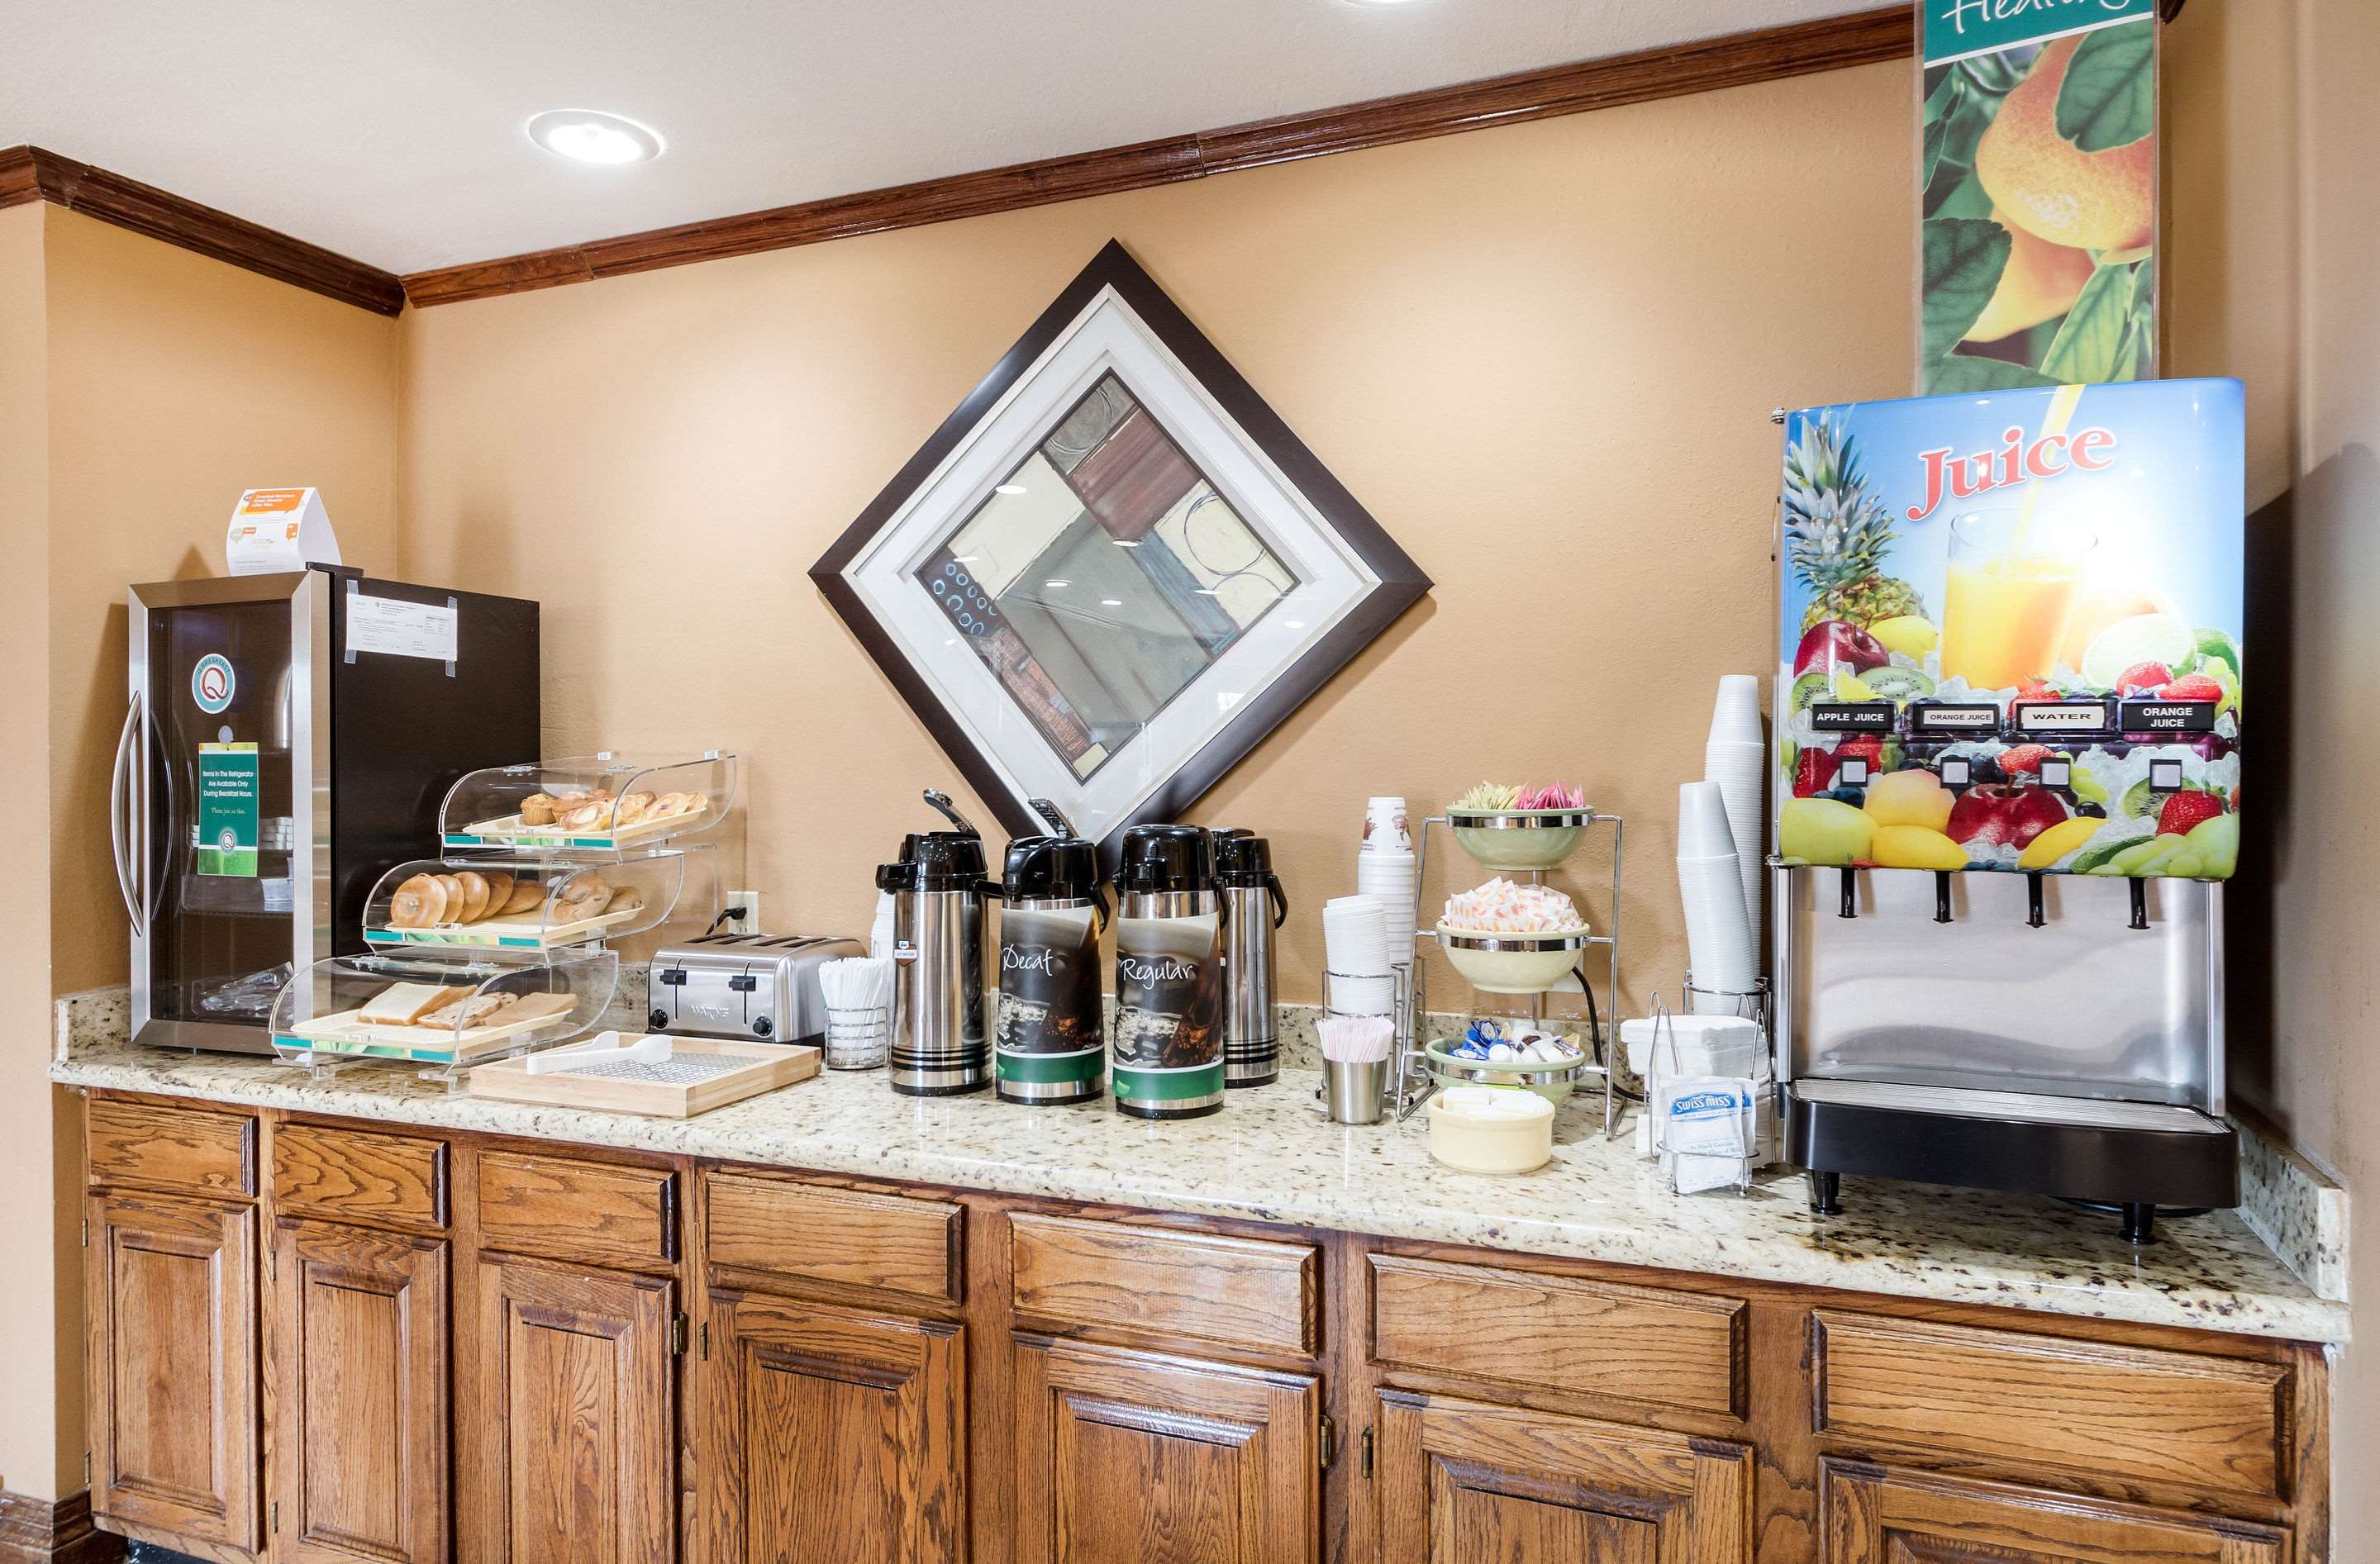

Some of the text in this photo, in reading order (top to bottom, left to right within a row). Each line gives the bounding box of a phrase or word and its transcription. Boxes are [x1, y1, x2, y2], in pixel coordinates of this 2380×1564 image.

[1906, 426, 2116, 521] Juice
[2032, 712, 2092, 720] WATER
[2143, 707, 2193, 716] ORANGE
[1816, 712, 1885, 722] APPLE JUICE
[2150, 718, 2185, 728] JUICE
[228, 770, 255, 779] Refrigerator
[203, 790, 219, 798] During
[1002, 943, 1054, 977] Decaf
[1120, 958, 1193, 991] Regular
